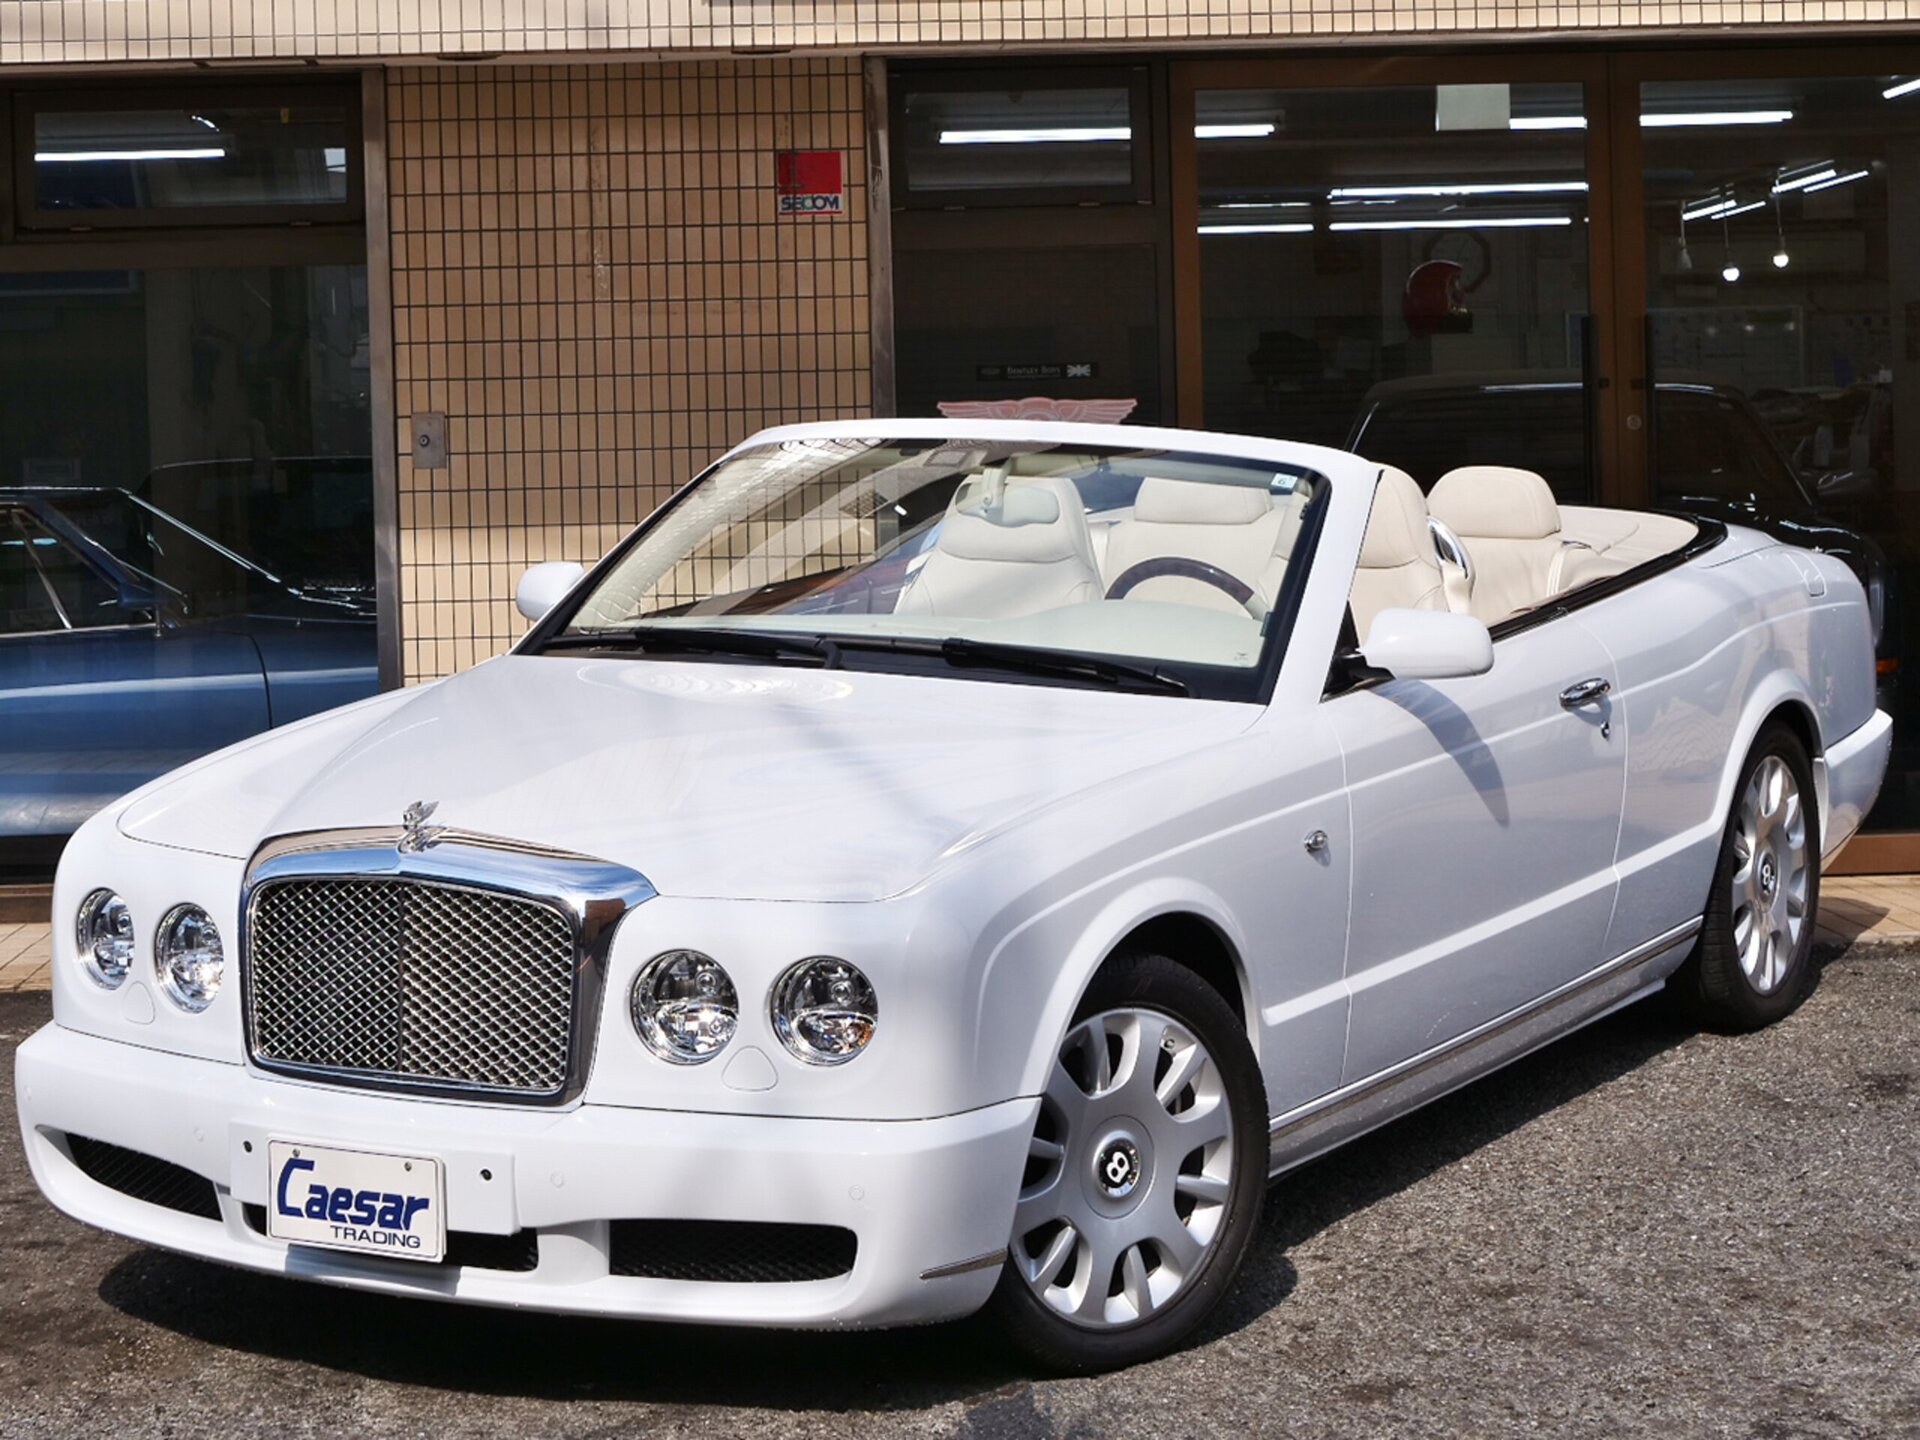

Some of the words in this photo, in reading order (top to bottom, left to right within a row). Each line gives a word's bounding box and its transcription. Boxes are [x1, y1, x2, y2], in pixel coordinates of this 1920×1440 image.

[781, 195, 839, 210] SECOM
[277, 1157, 429, 1230] Caesar
[330, 1225, 421, 1249] TRADING
